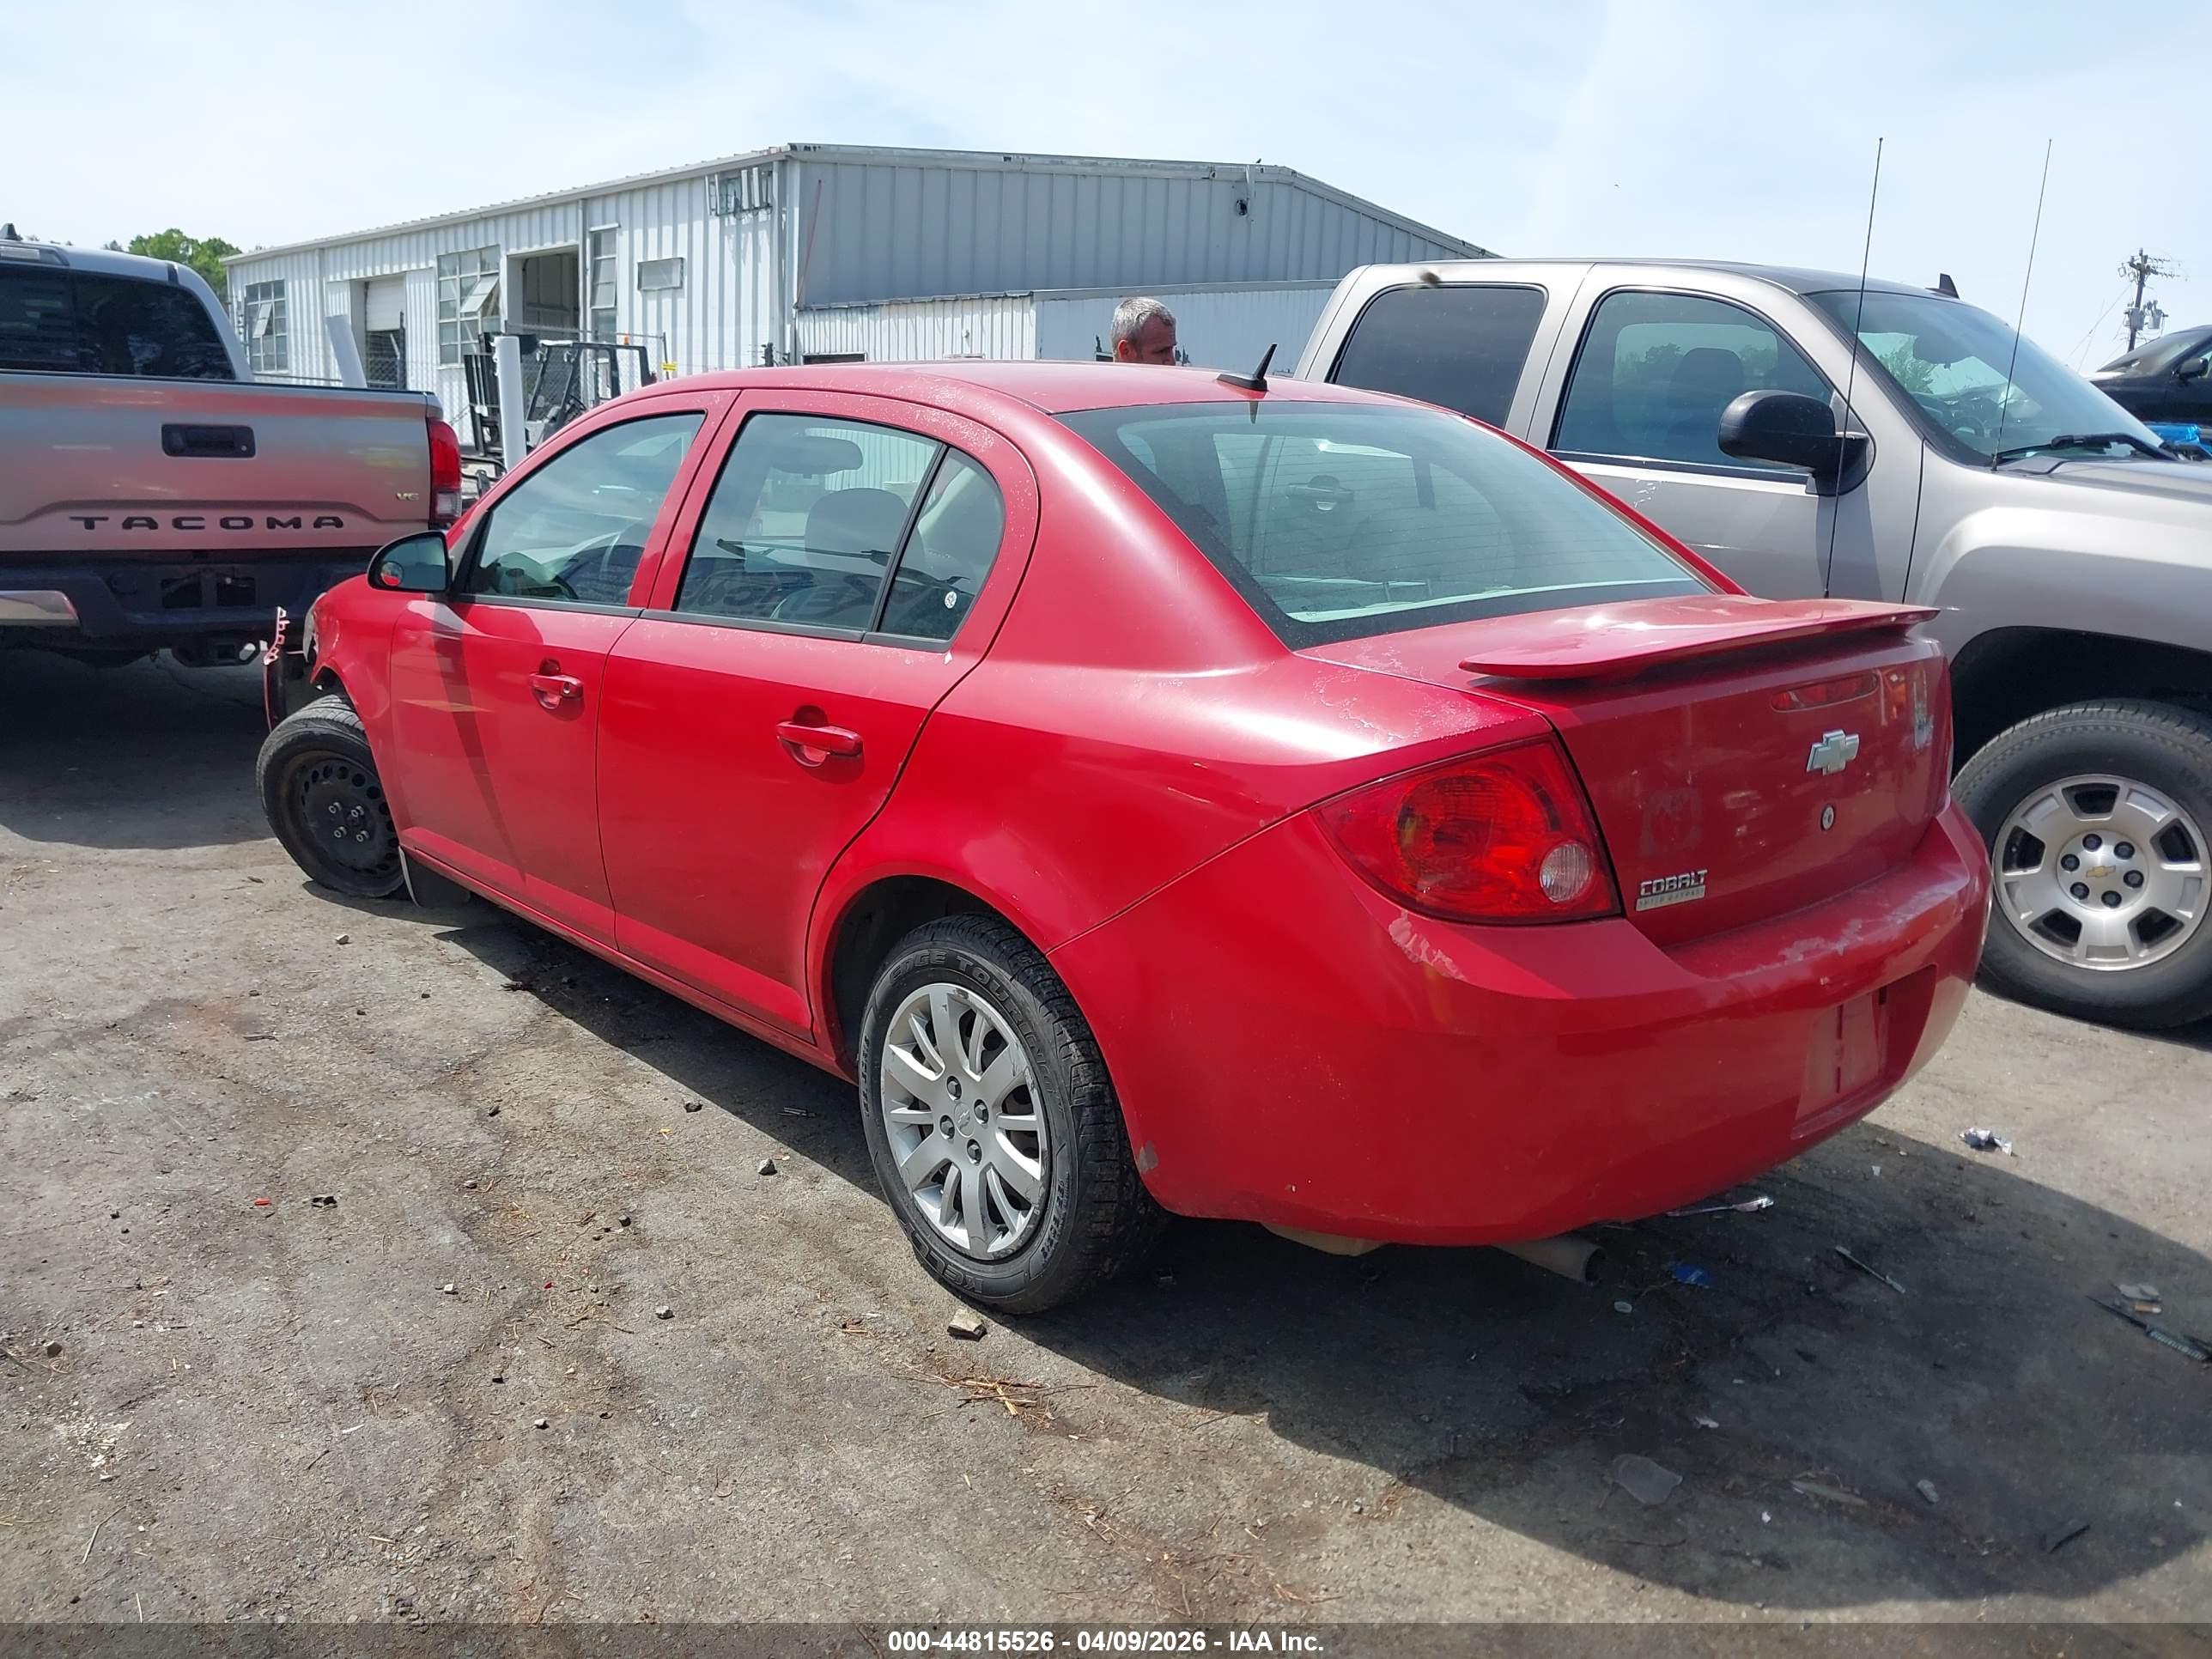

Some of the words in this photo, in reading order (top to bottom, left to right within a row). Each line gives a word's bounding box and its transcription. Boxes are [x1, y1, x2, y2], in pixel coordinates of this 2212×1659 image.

[69, 515, 344, 531] TACOMA
[1639, 868, 1708, 896] COBALT
[889, 948, 946, 984] EDGE
[898, 1218, 984, 1294] KELLY
